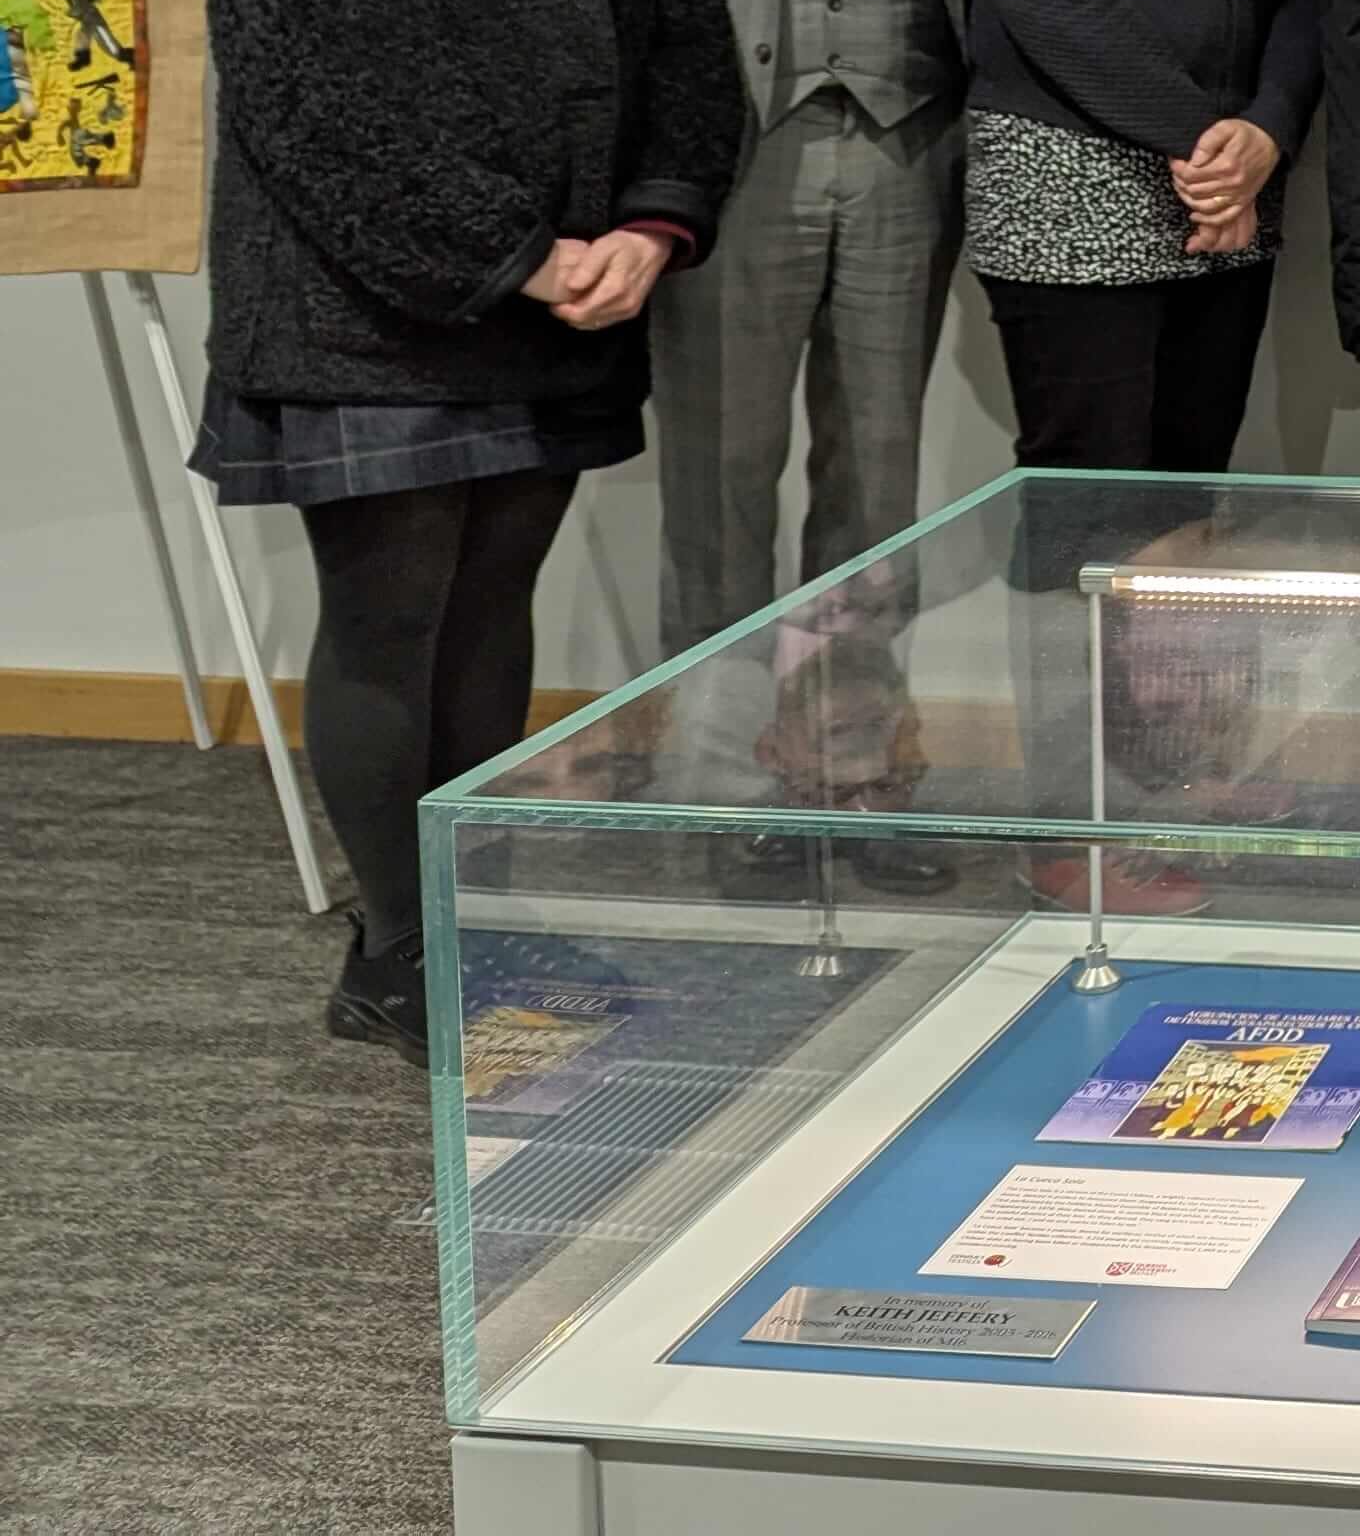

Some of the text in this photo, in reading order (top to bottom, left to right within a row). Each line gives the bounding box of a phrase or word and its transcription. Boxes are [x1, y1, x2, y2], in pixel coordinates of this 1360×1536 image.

[1225, 1026, 1305, 1043] AFDD
[884, 1296, 992, 1310] In memory of
[834, 1305, 1017, 1325] KEITH JEFFERY
[769, 1316, 841, 1329] Professor
[845, 1320, 862, 1330] of
[863, 1321, 915, 1332] British
[918, 1324, 972, 1338] History
